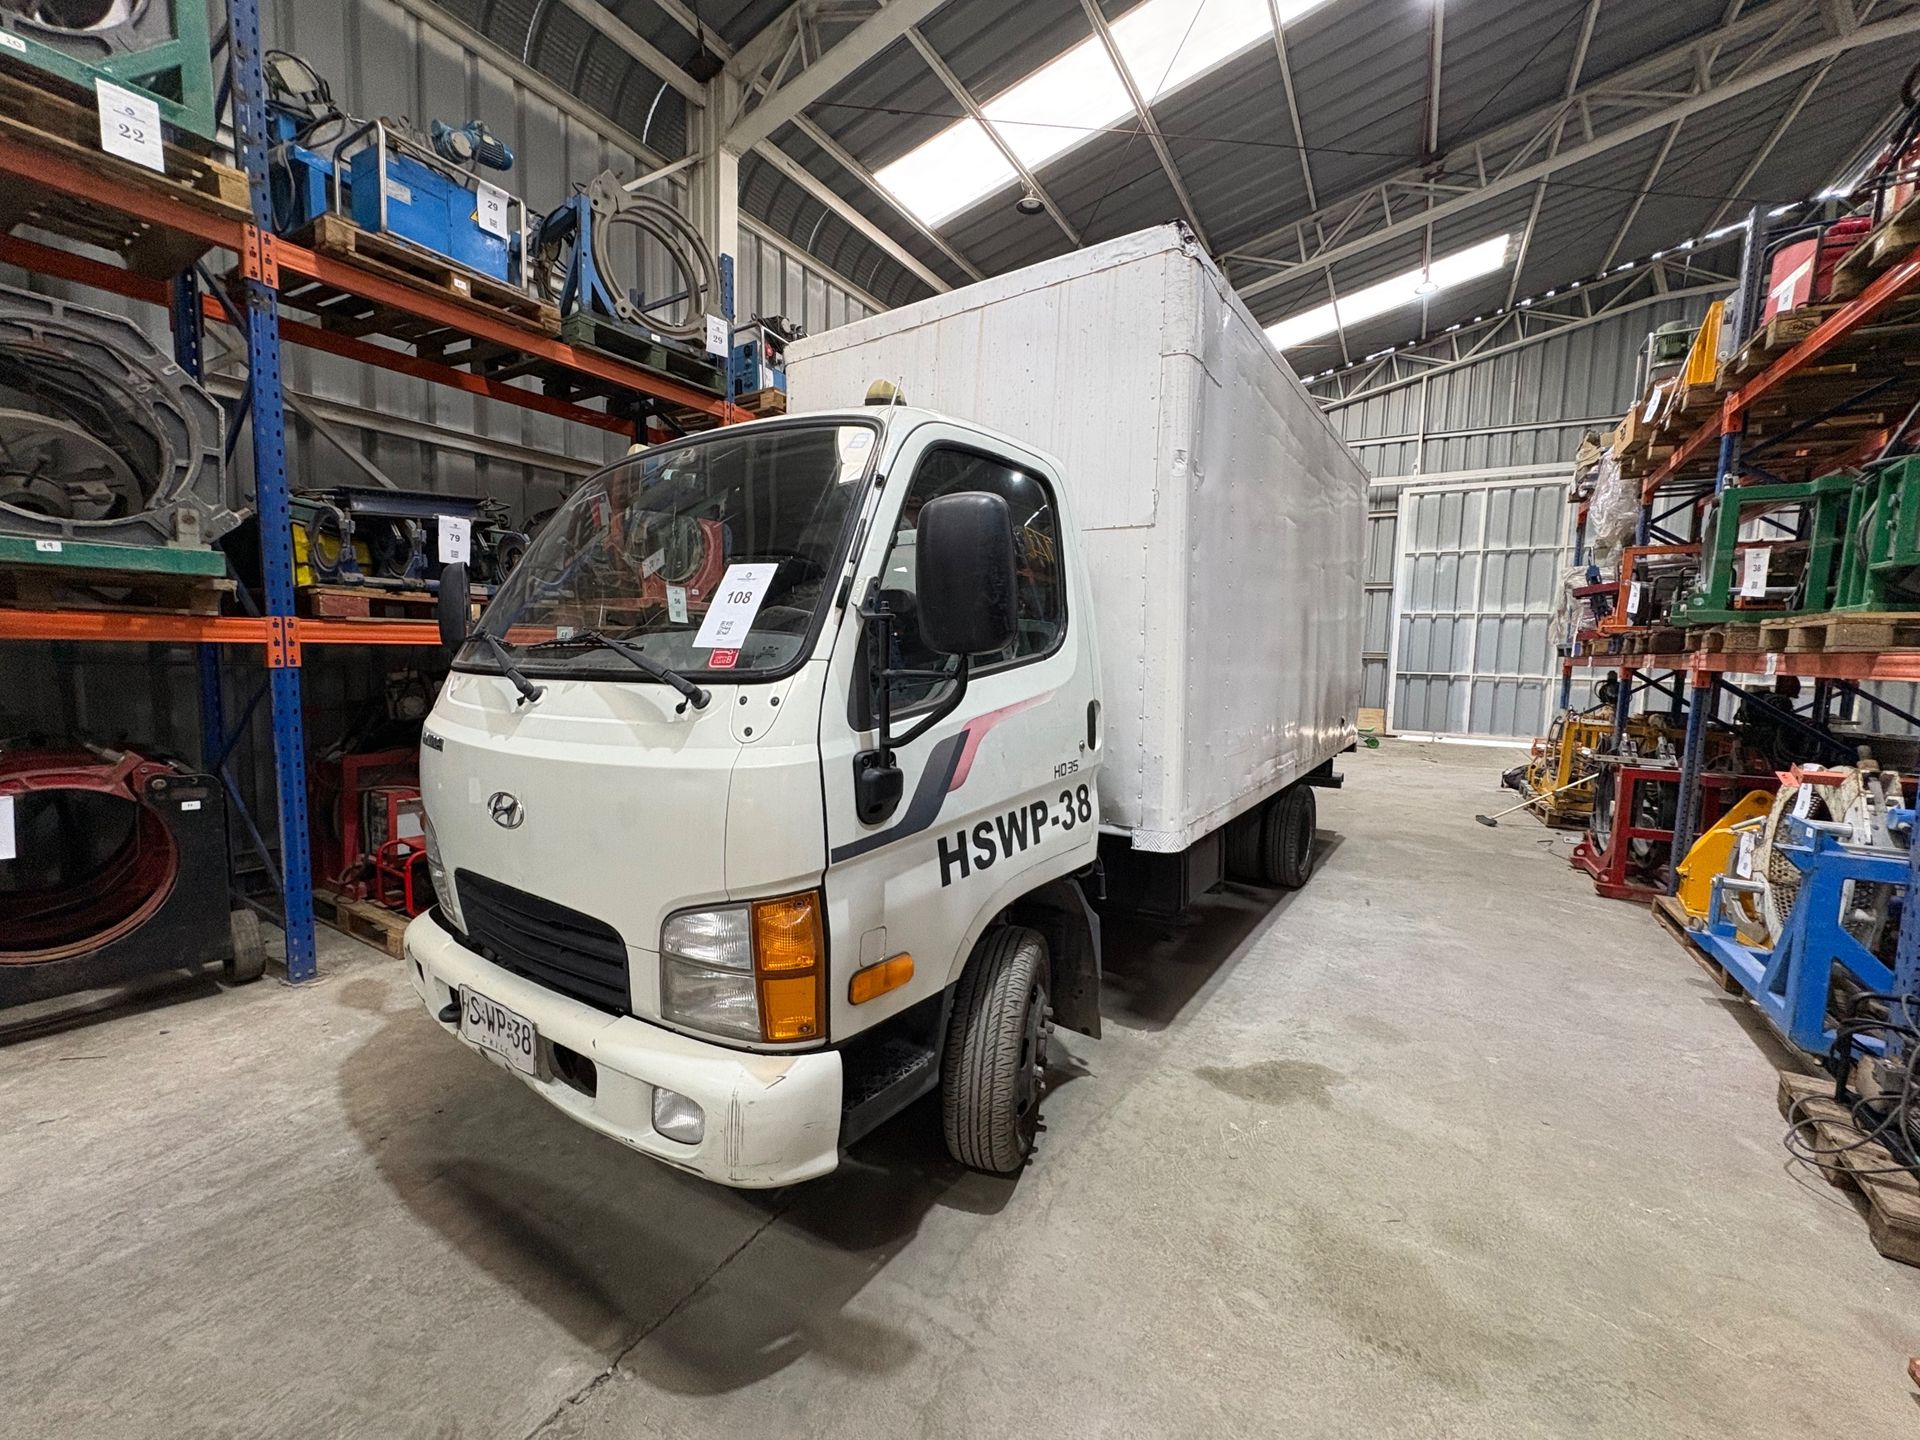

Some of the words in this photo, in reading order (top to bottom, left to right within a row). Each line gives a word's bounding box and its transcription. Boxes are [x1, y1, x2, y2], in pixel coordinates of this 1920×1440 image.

[118, 122, 145, 145] 22
[487, 200, 498, 212] 29
[712, 334, 723, 345] 29
[449, 533, 461, 543] 79
[727, 591, 753, 605] 108
[936, 783, 1092, 888] HSWP-38
